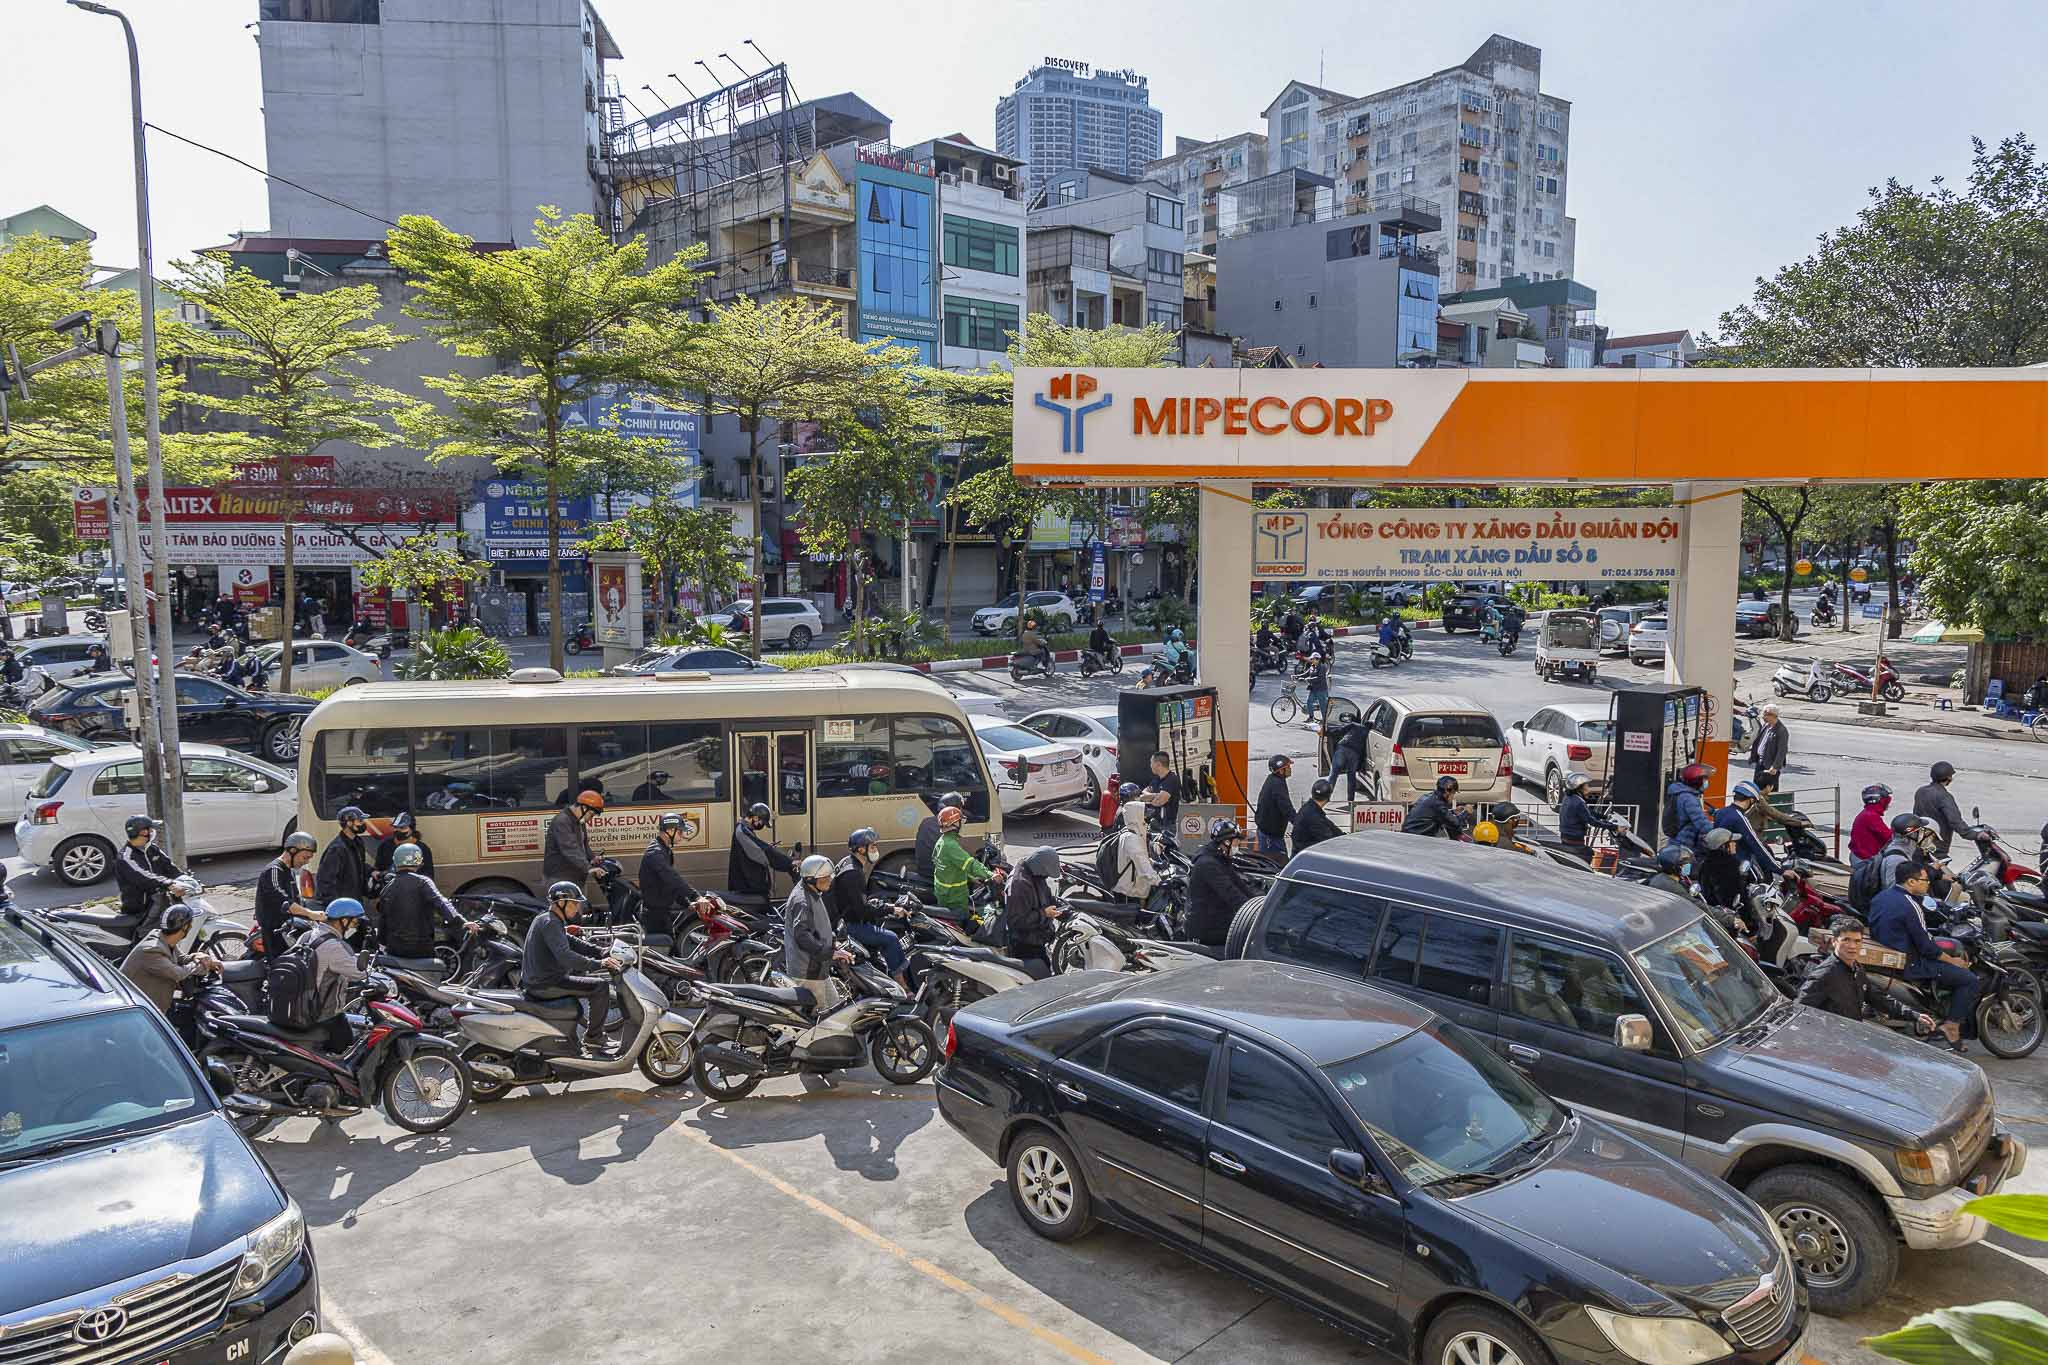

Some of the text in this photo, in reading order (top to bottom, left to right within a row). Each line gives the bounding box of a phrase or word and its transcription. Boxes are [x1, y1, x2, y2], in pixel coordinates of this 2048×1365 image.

[1044, 56, 1089, 72] DISCOVERY
[1050, 373, 1097, 400] MP
[1133, 396, 1393, 437] MIPECORP
[1317, 511, 1679, 544] TỔNG CÔNG TY XĂNG DẦU QUÂN ĐỘI
[174, 531, 199, 547] TÂM
[203, 531, 227, 547] BẢO
[231, 531, 276, 547] DƯỠNG
[491, 549, 510, 559] BIỆT
[1400, 540, 1598, 568] TRẠM XĂNG DẦU SỐ 8
[1257, 565, 1303, 574] MIPECORP
[1352, 565, 1387, 577] NGUYỄN
[1389, 568, 1421, 577] PHONG
[1506, 566, 1522, 578] NỘI
[1633, 568, 1654, 577] 3756
[1655, 568, 1675, 577] 7858
[1356, 806, 1402, 827] MẤT ĐIỆN
[590, 832, 619, 843] GUYỄN
[642, 832, 658, 841] KHI
[226, 1337, 249, 1361] CN
